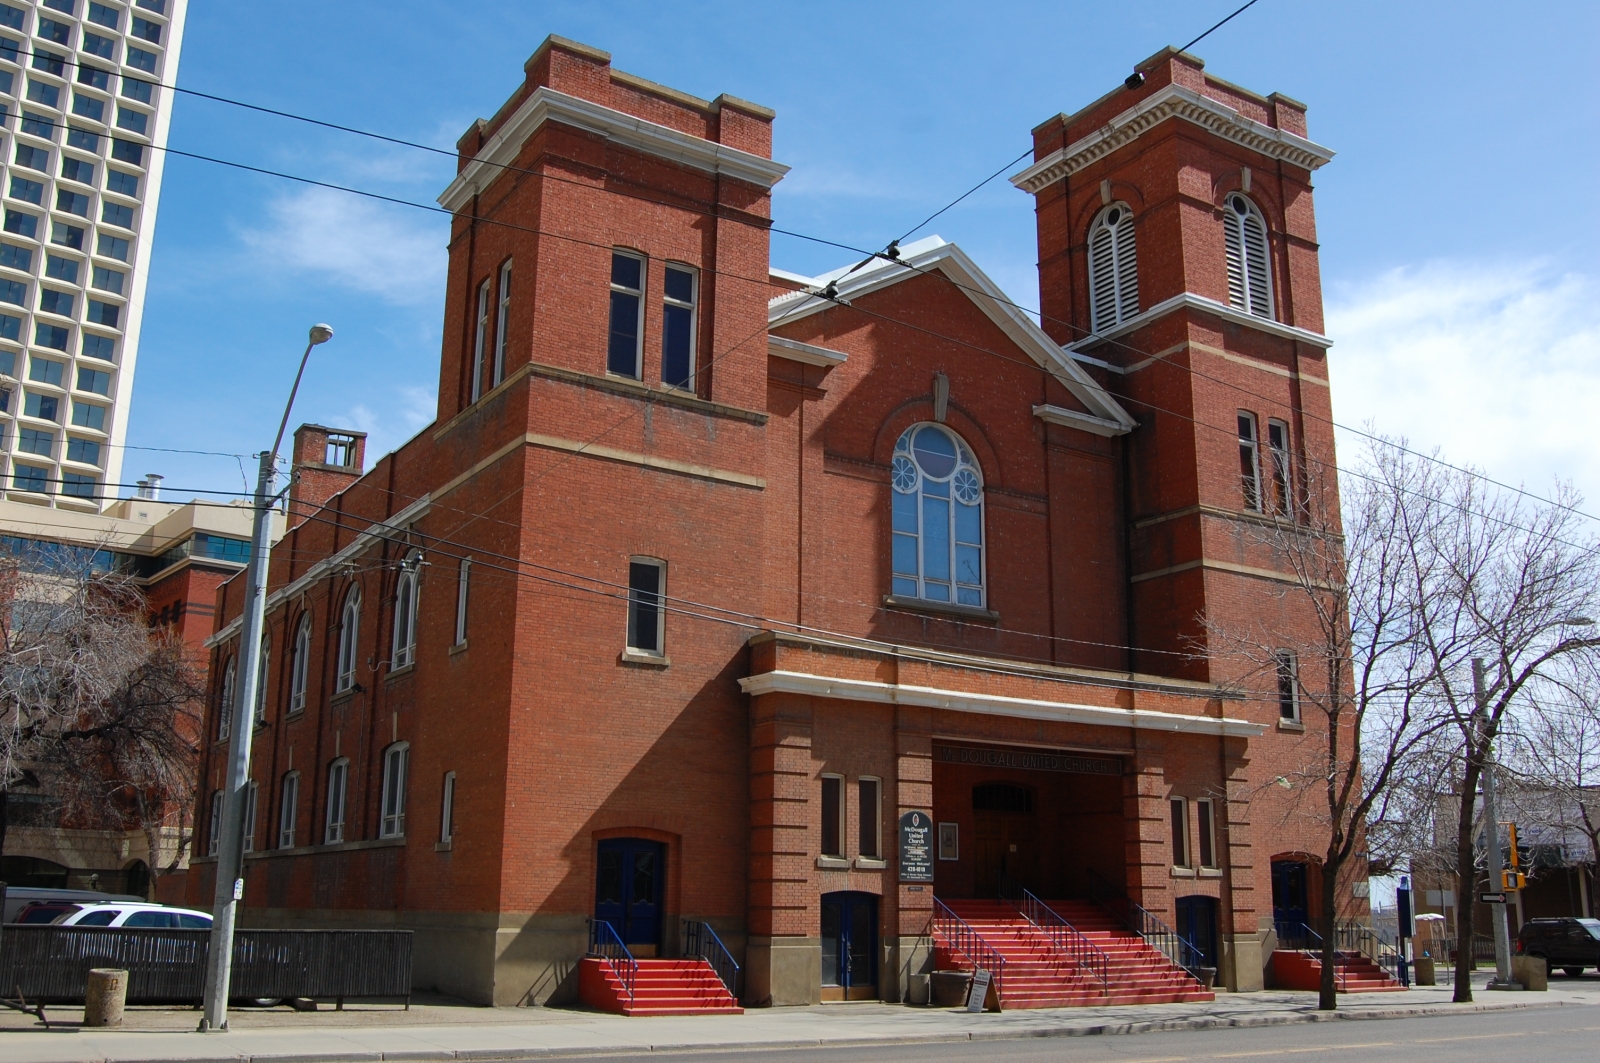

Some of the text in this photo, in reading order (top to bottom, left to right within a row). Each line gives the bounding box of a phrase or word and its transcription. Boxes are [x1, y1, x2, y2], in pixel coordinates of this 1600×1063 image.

[961, 749, 1017, 767] DOUGALL
[1022, 755, 1058, 770] UNITED
[1064, 758, 1107, 773] CHURCH
